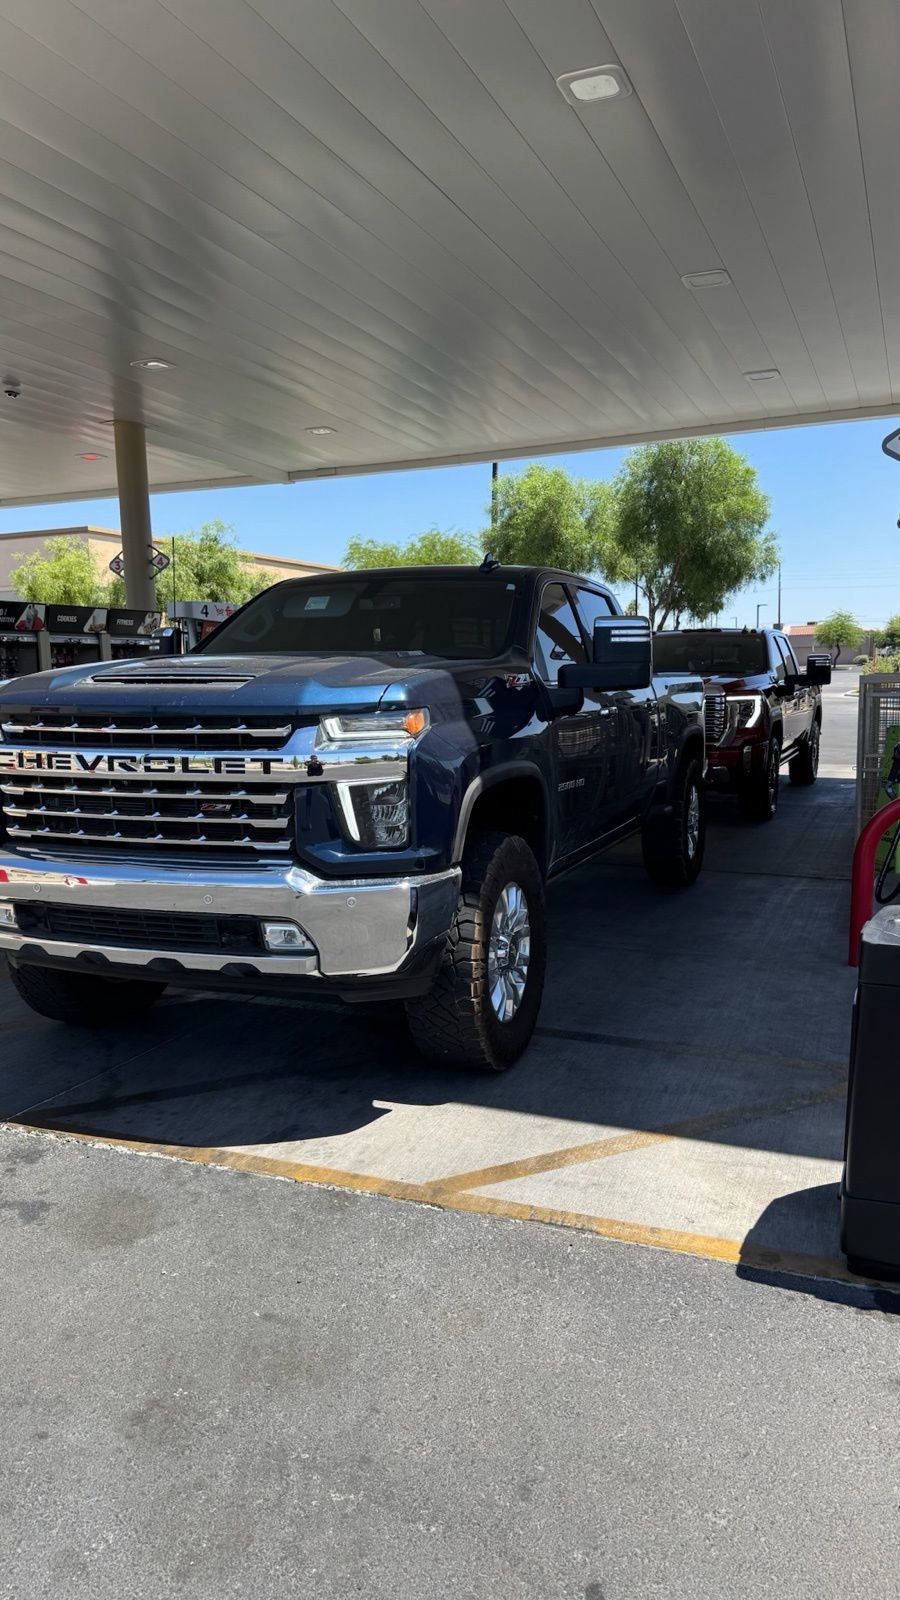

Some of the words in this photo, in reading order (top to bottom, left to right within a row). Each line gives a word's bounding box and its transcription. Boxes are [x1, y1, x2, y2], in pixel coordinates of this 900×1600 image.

[114, 560, 121, 570] 3
[156, 557, 164, 567] 4
[200, 604, 209, 618] 4
[56, 615, 78, 623] COOKIES
